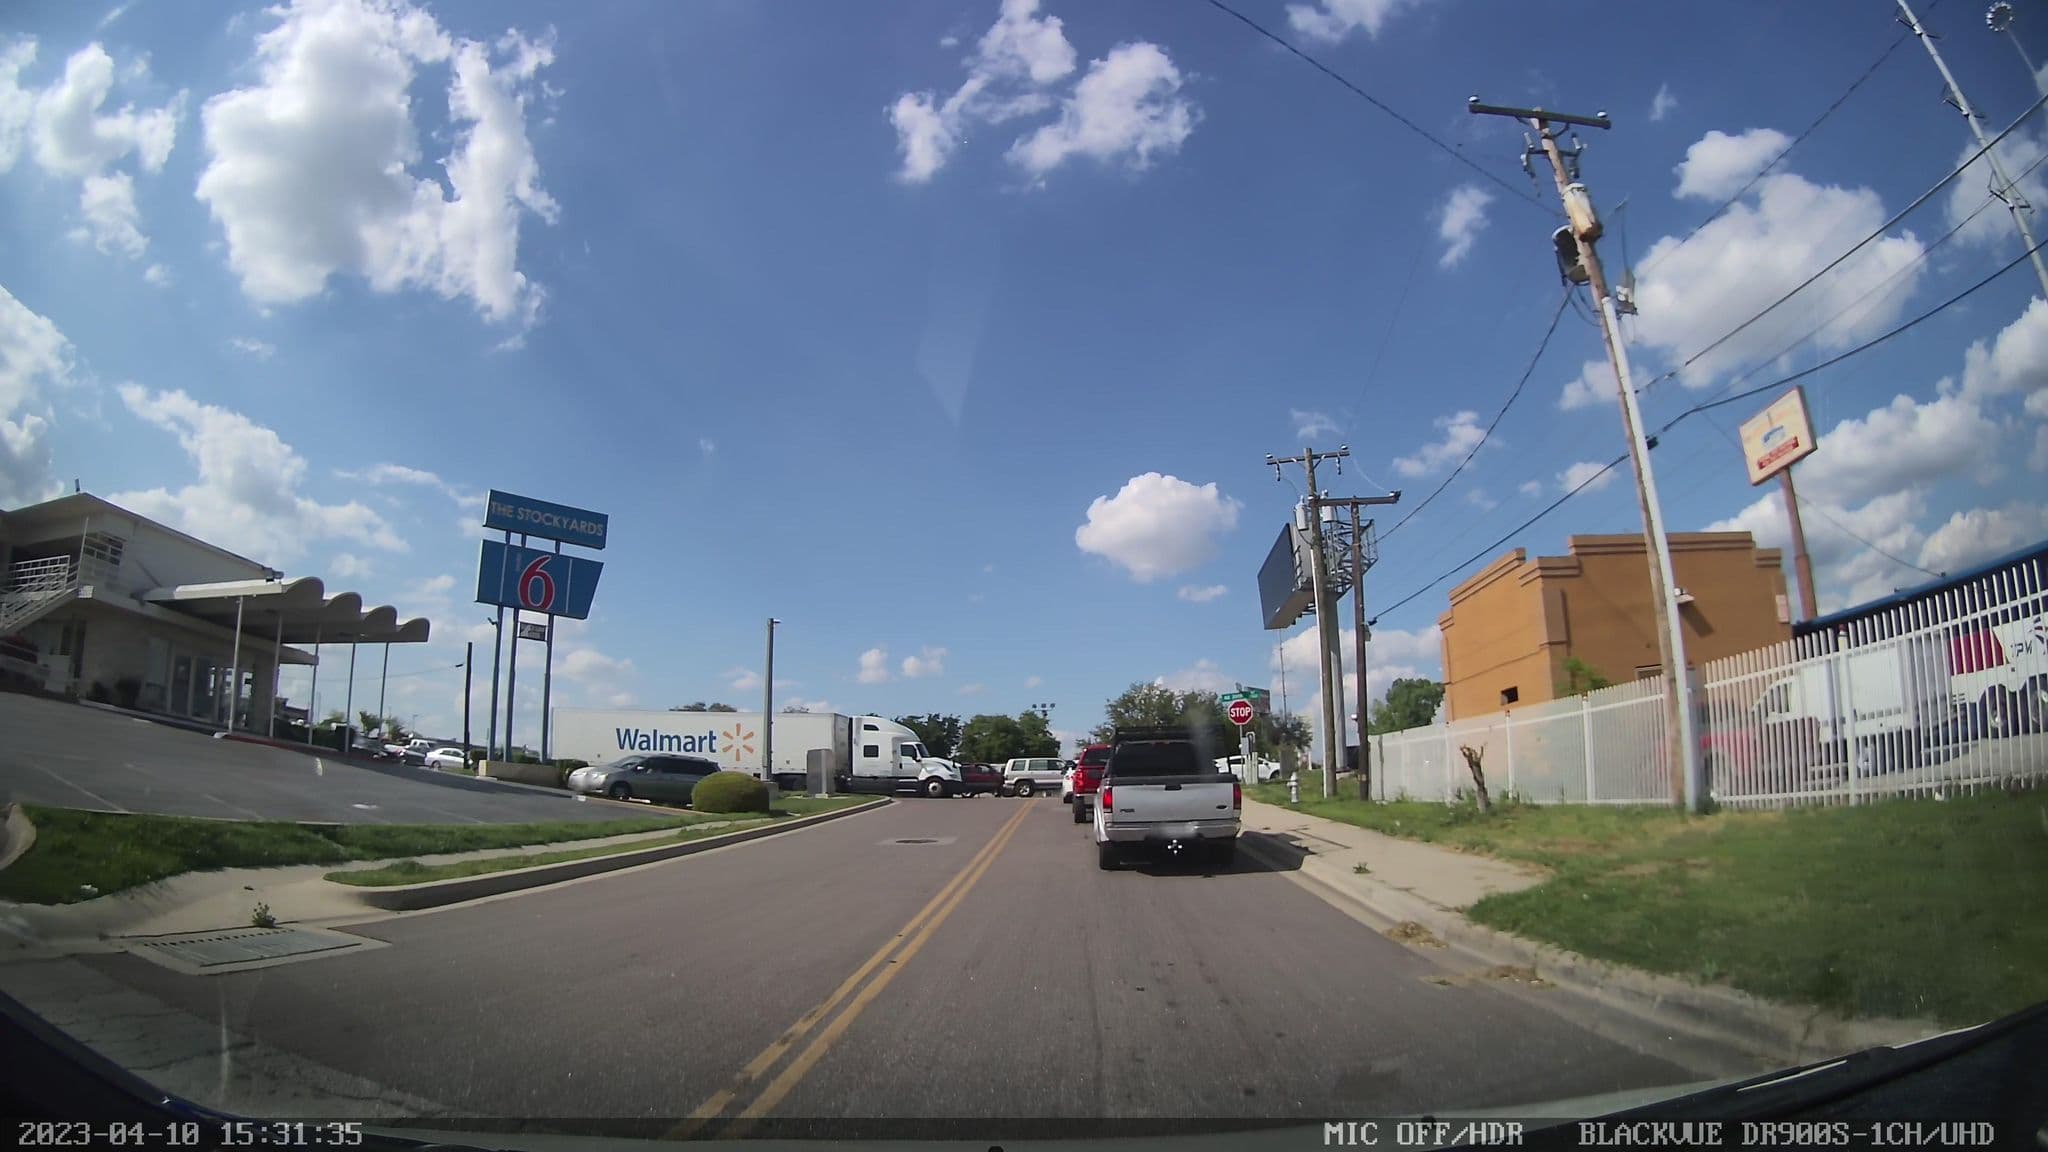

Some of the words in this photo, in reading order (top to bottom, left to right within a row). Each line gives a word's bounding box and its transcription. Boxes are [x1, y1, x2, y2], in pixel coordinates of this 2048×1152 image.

[491, 501, 514, 517] THE
[517, 506, 604, 537] STOCKYARDS
[518, 555, 555, 611] 6
[1230, 707, 1251, 718] STOP
[616, 728, 717, 753] Walmart
